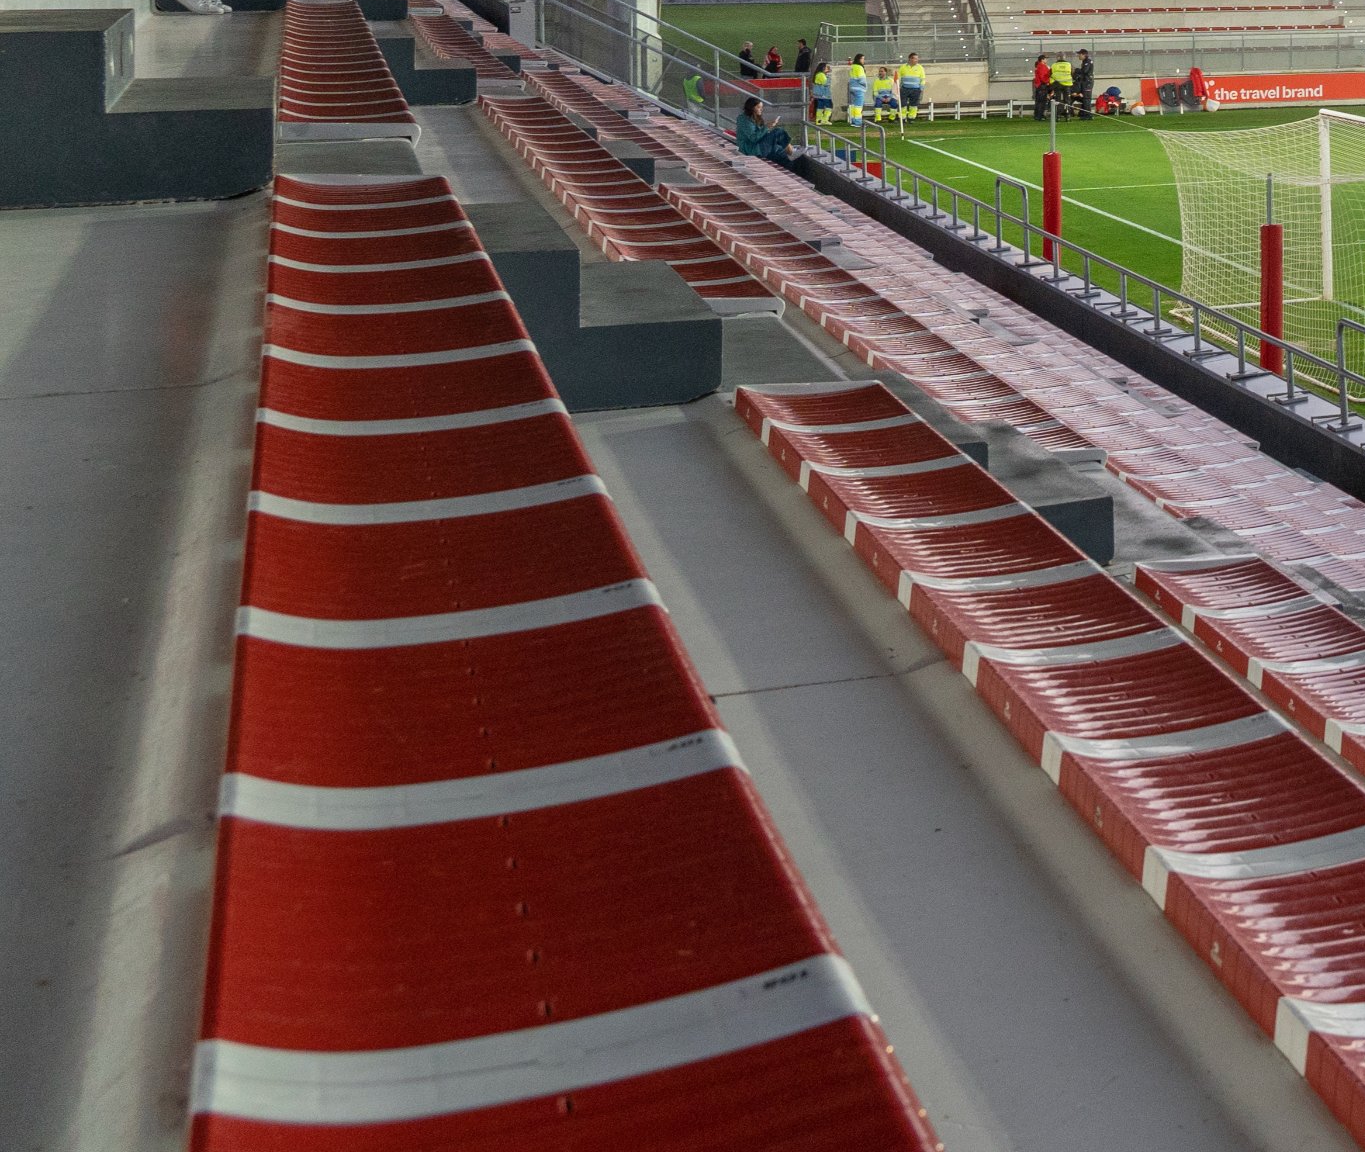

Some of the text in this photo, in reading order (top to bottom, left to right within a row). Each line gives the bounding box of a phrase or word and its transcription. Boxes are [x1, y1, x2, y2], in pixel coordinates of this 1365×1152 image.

[1214, 84, 1323, 100] the travel brand
